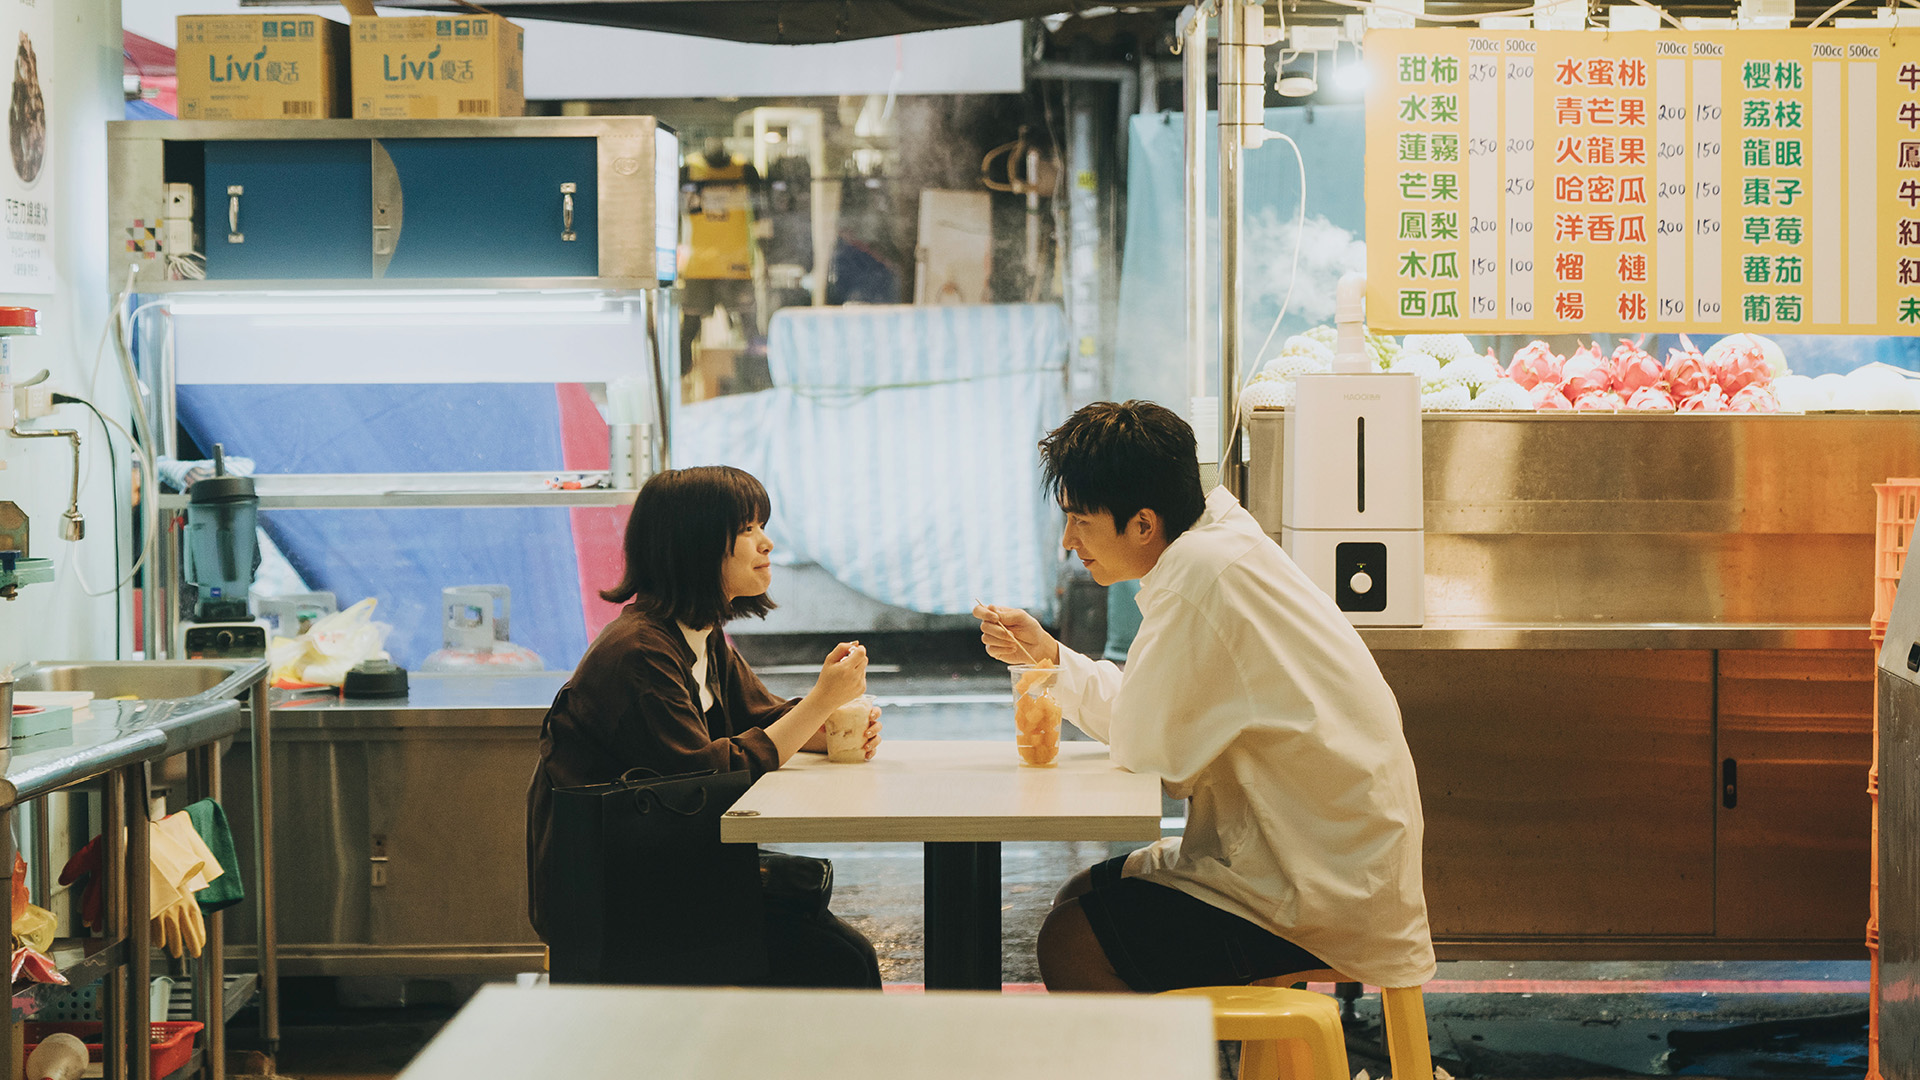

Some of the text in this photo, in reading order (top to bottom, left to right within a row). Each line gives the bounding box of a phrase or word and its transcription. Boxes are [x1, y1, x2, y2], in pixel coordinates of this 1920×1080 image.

[1468, 38, 1537, 53] 700cc 500cc
[1656, 41, 1724, 57] 700cc 500cc
[1812, 44, 1880, 58] 700cc 500cc
[209, 45, 266, 82] Livi
[383, 44, 440, 81] Livi
[1399, 56, 1535, 84] 甜柿 250 200
[1556, 58, 1646, 87] 水蜜桃
[1743, 61, 1803, 90] 櫻桃
[1399, 94, 1458, 123] 水梨
[1556, 96, 1723, 126] 青芒果 200 150
[1743, 99, 1803, 129] 荔枝
[1399, 133, 1536, 162] 蓮霧 250 200
[1556, 136, 1721, 165] 火龍果 200 150
[1743, 138, 1803, 167] 龍眼
[1399, 172, 1536, 201] 芒果 250
[1556, 175, 1721, 204] 哈密瓜 200 150
[1743, 177, 1803, 206] 棗子
[1399, 211, 1533, 240] 鳳梨 200 100
[1555, 214, 1721, 243] 洋香瓜 200 150
[1743, 216, 1803, 246] 草莓
[1399, 250, 1534, 279] 木瓜 150 100
[1743, 255, 1802, 284] 蕃茄
[1400, 290, 1533, 318] 西瓜 150 100
[1659, 298, 1684, 316] 150
[1697, 298, 1721, 317] 100
[1743, 294, 1803, 323] 葡萄
